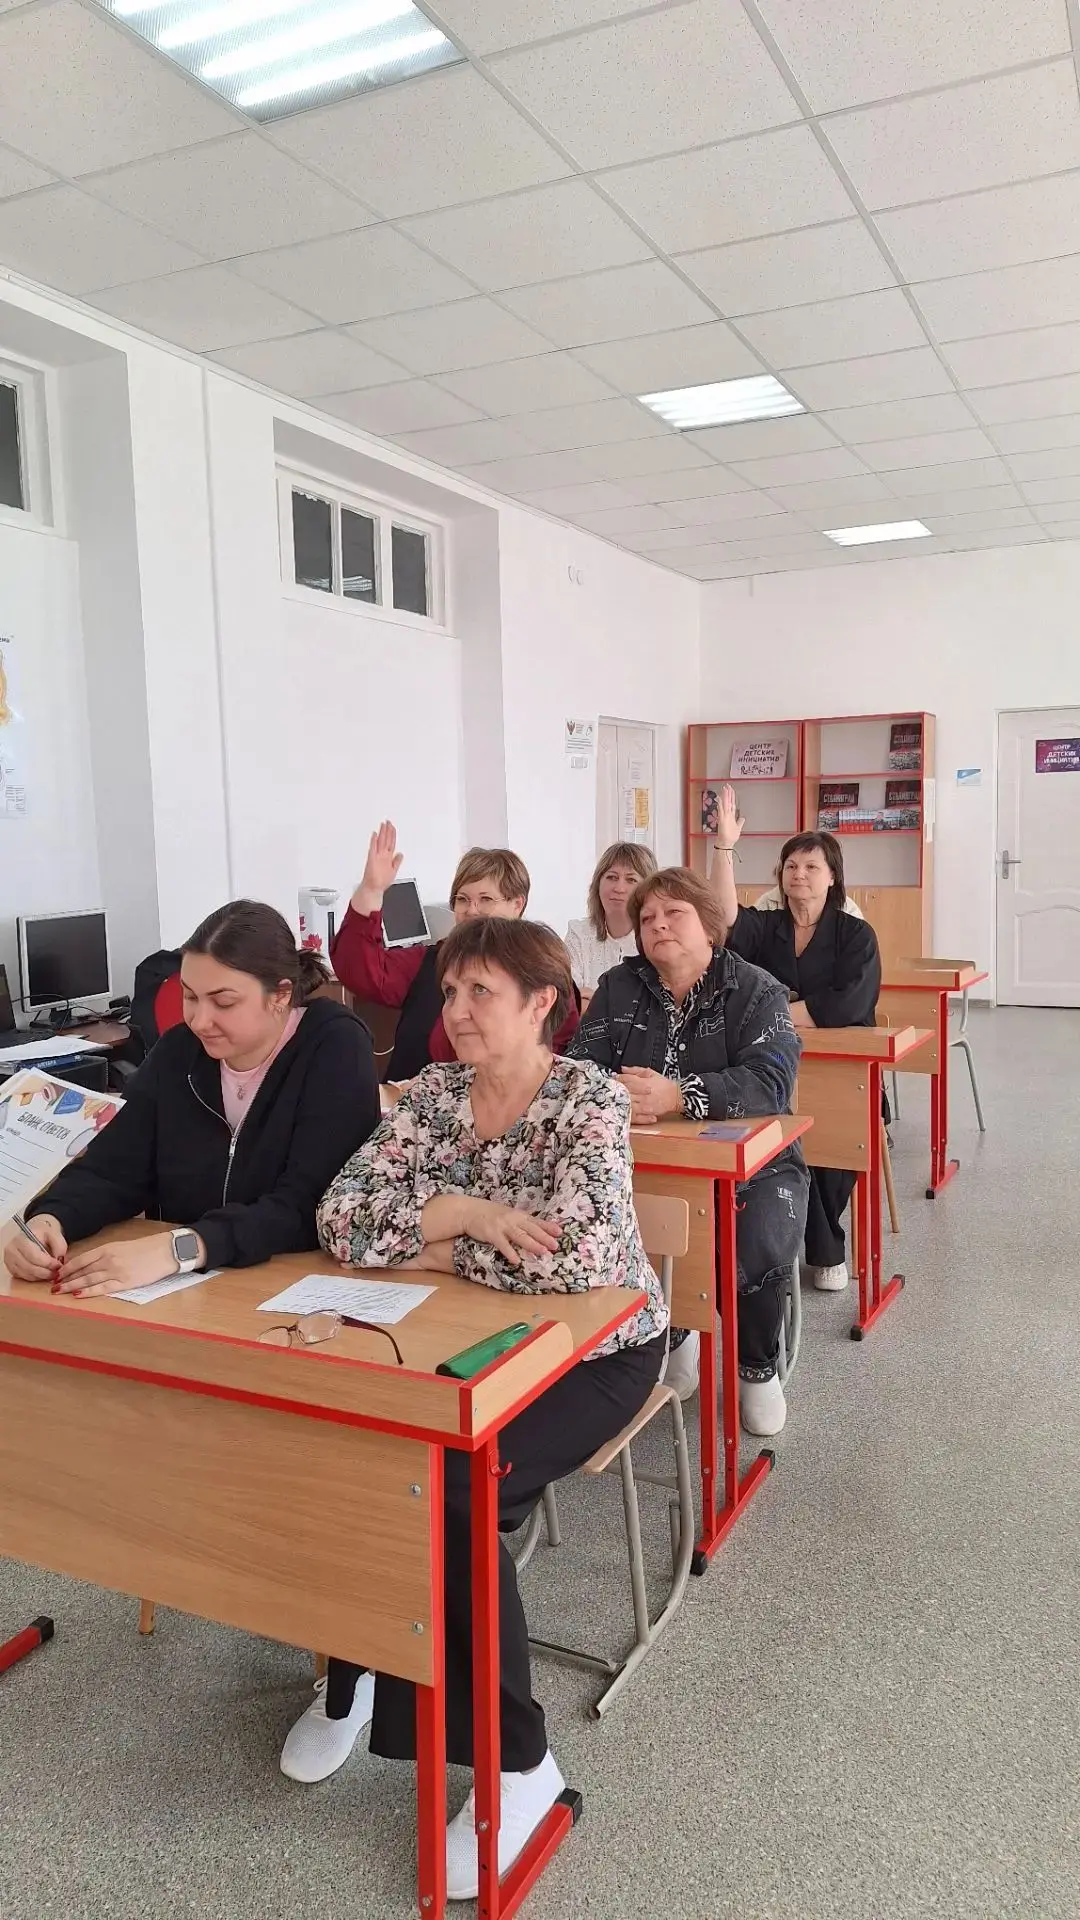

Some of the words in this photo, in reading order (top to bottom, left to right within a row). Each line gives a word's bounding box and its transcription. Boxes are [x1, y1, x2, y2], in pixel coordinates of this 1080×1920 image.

[744, 749, 775, 757] ДЕТСКИХ
[17, 1111, 45, 1129] БЛАНК
[40, 1121, 71, 1139] ОТВЕТОВ
